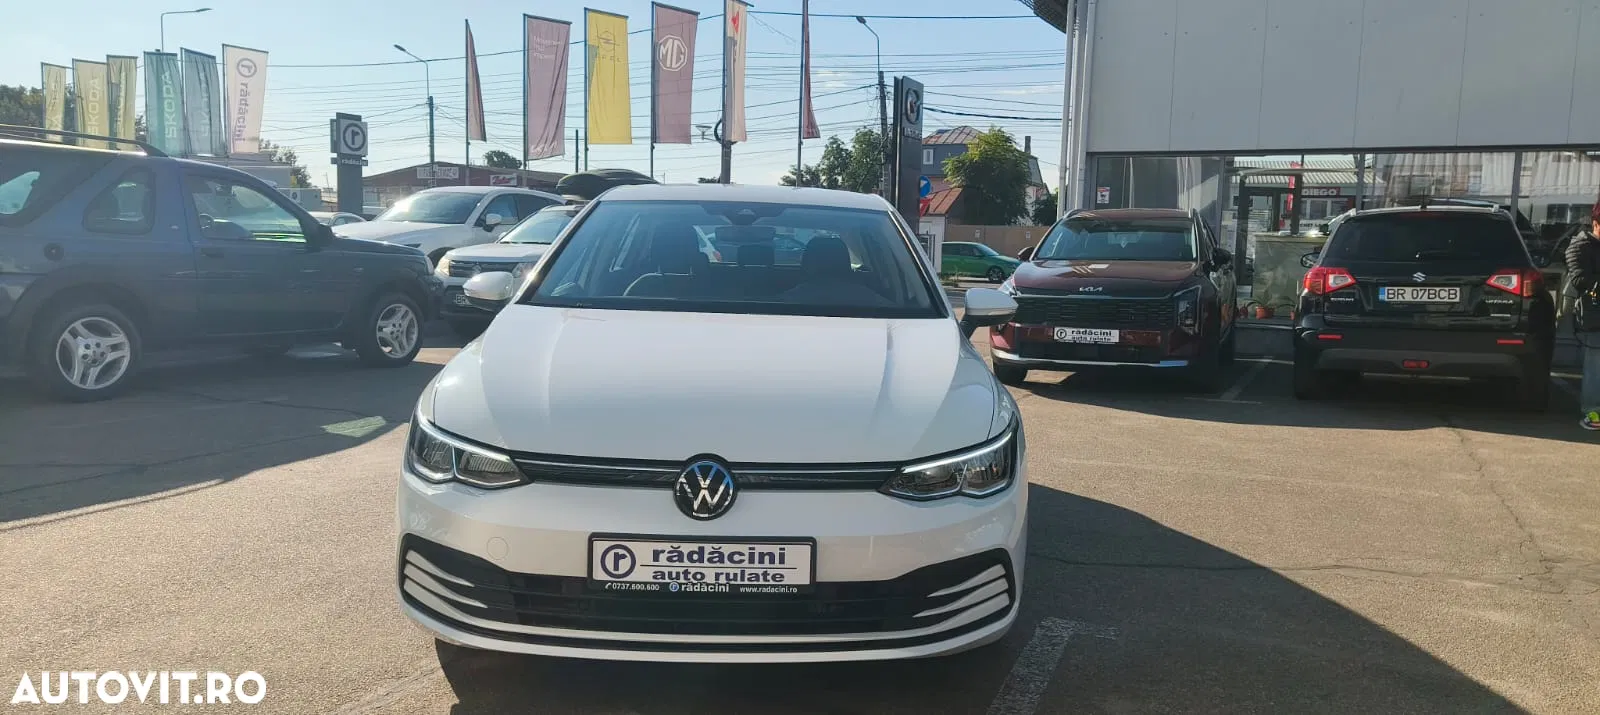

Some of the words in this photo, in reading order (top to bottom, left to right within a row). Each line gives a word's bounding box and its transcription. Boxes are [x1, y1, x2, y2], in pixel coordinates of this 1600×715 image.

[660, 39, 684, 68] MG
[1302, 188, 1337, 196] DIEGO
[1387, 288, 1406, 300] BR
[1411, 288, 1458, 300] 07BCB
[652, 545, 786, 565] rădăcini
[652, 569, 706, 581] auto
[715, 569, 785, 582] rulate
[681, 582, 729, 593] rădăcini
[739, 586, 798, 594] www.radacini.ro
